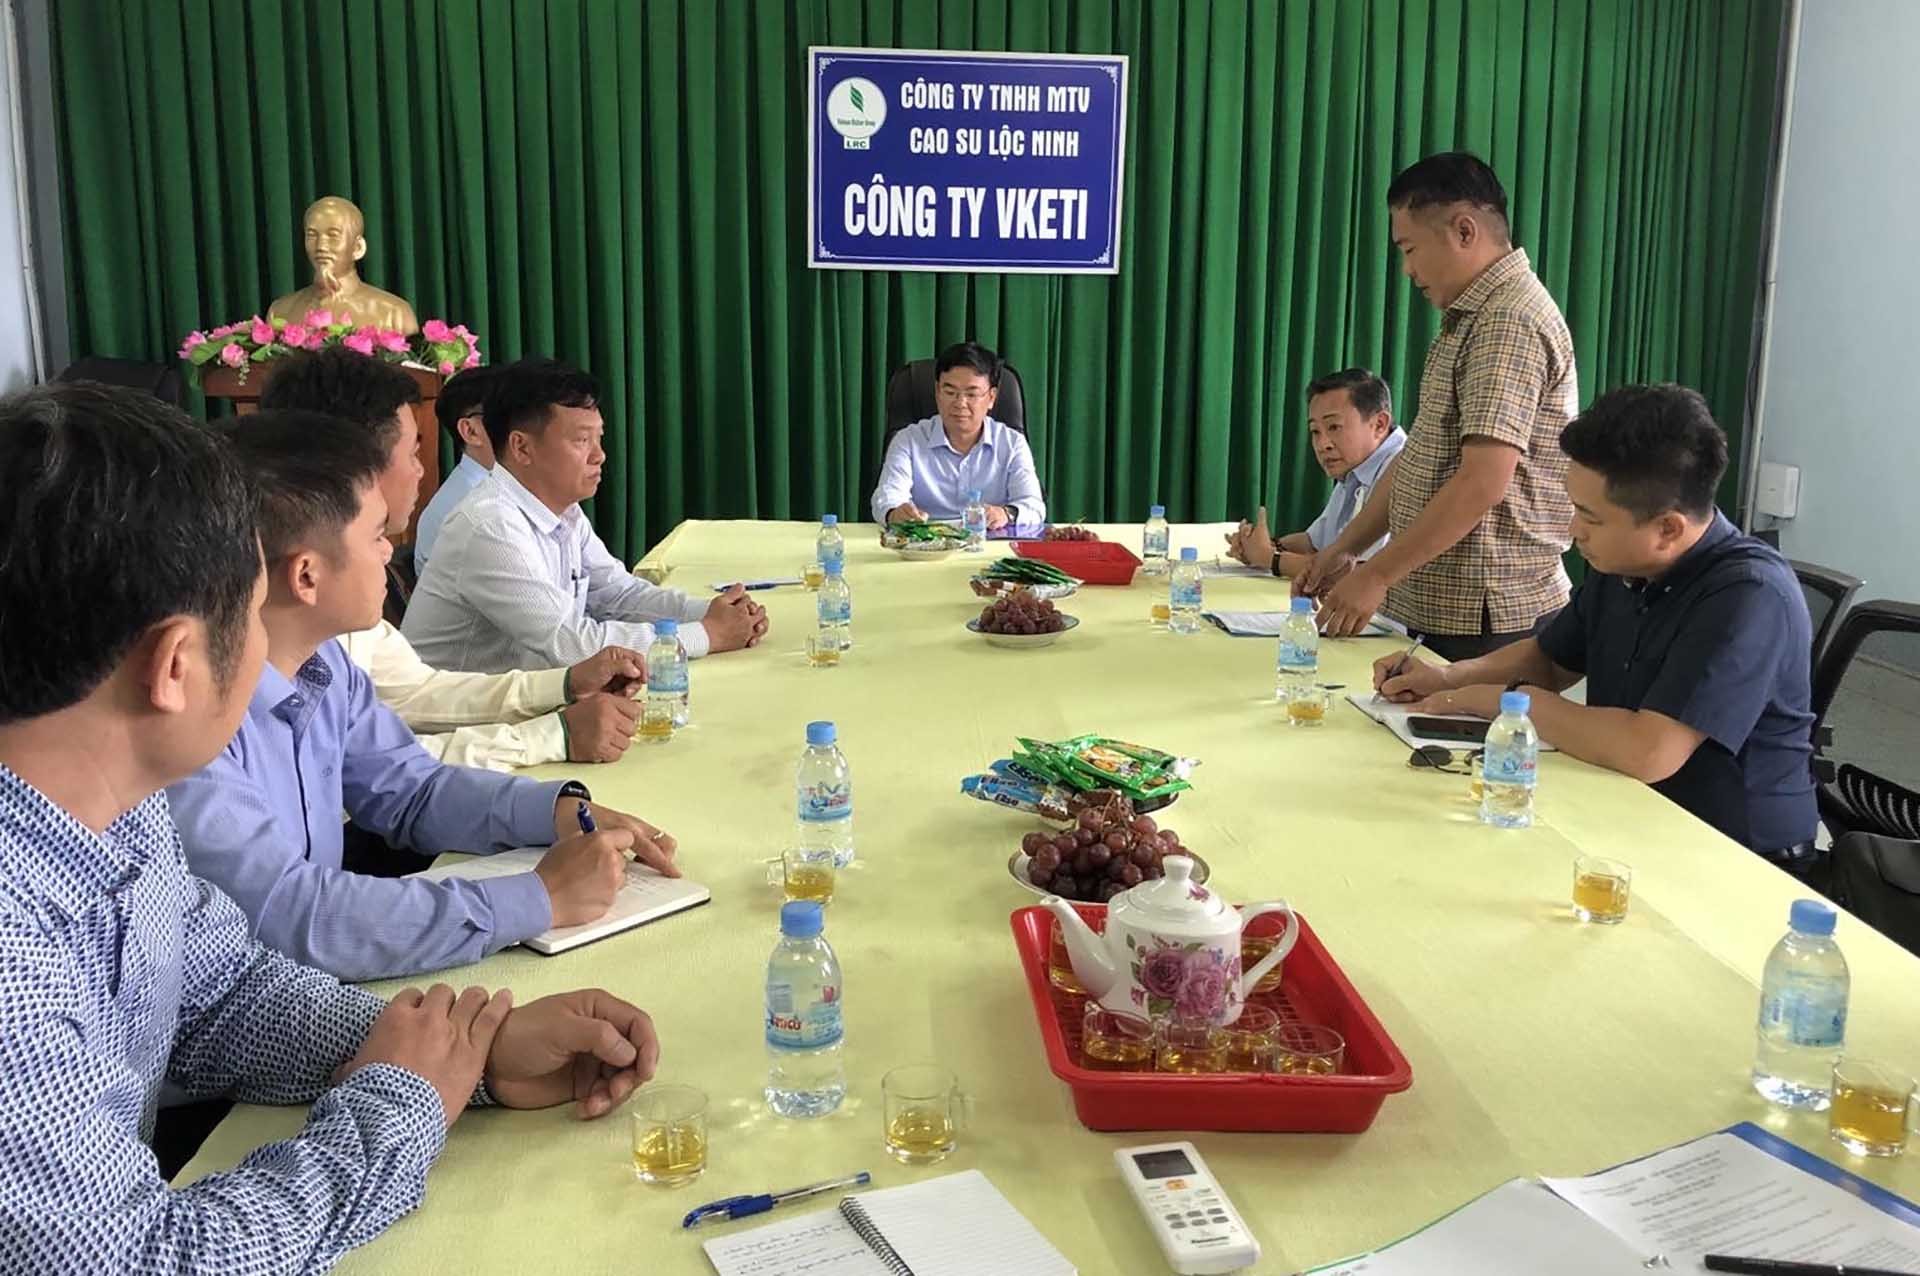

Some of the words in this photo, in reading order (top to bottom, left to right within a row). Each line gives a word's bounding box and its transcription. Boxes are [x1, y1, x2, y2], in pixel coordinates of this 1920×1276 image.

[901, 77, 954, 110] CÔNG
[961, 84, 984, 110] TY
[989, 84, 1040, 112] TNHH
[1047, 84, 1090, 113] MTV
[910, 127, 949, 154] CAO
[956, 128, 982, 155] SU
[989, 124, 1025, 161] LỘC
[1032, 130, 1079, 157] NINH
[844, 173, 936, 237] CÔNG
[947, 187, 986, 238] TY
[996, 188, 1088, 240] VKETI
